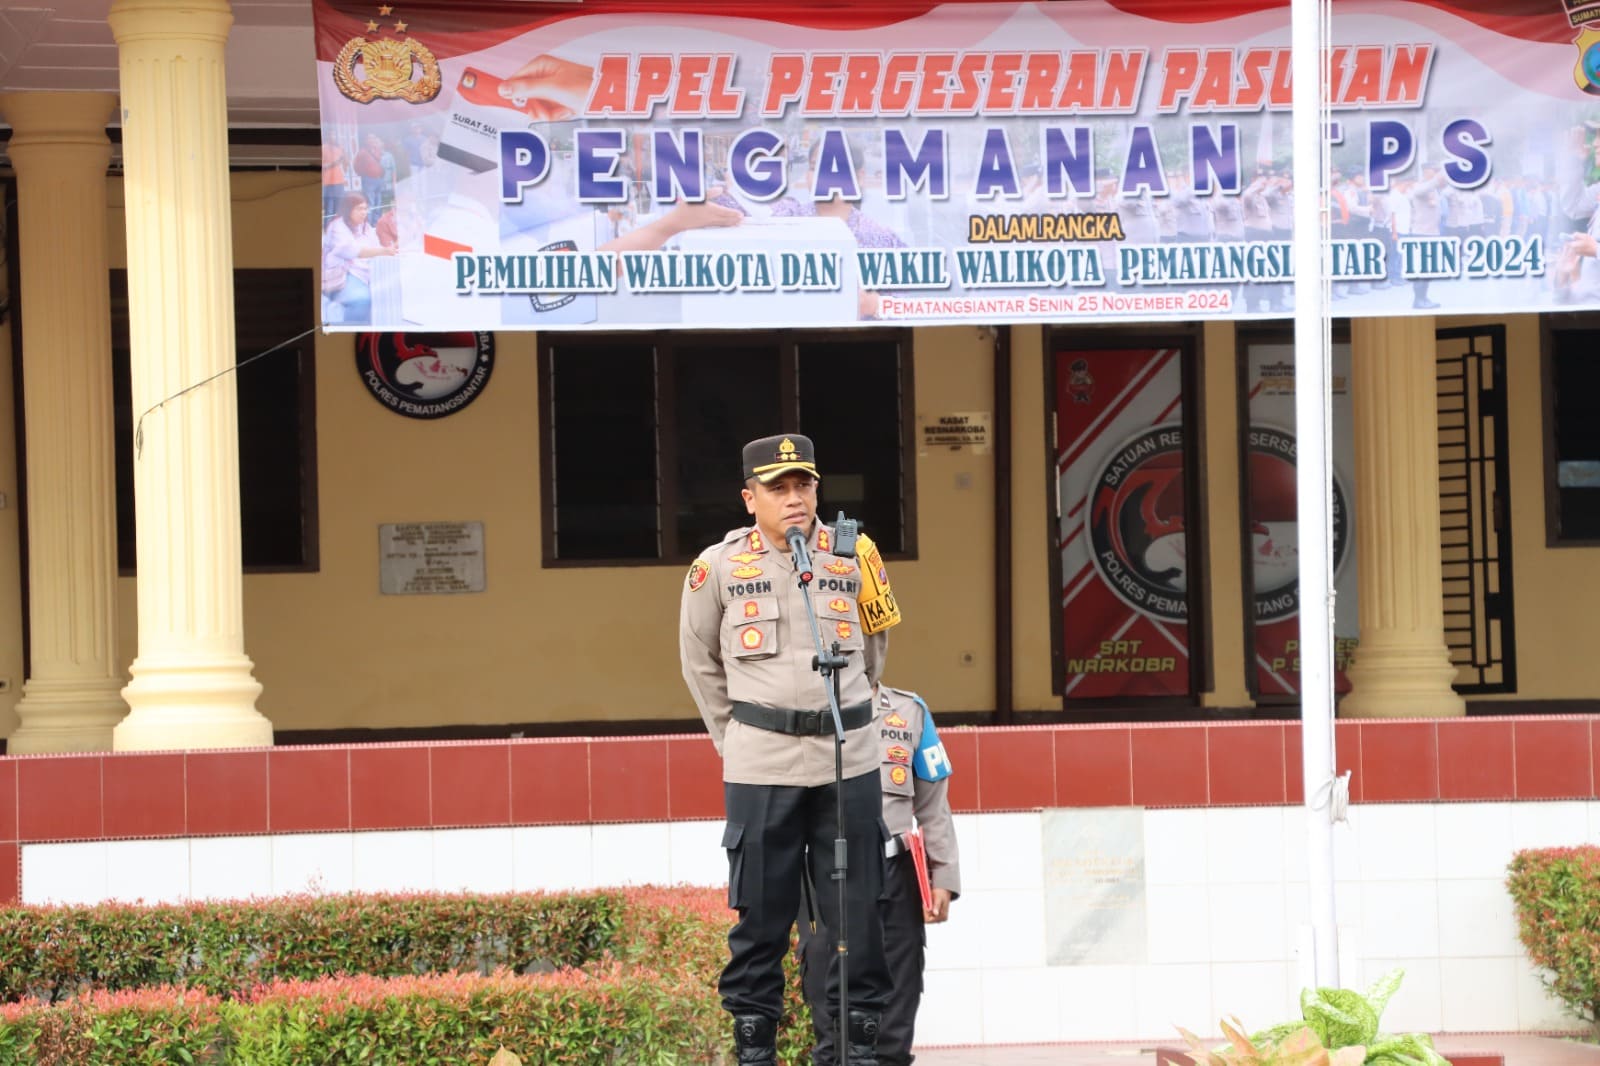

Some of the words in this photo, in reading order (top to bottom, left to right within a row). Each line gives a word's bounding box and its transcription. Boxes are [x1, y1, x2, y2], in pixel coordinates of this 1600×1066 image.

[586, 54, 742, 115] APEL
[765, 49, 1147, 114] PERGESERAN
[453, 114, 481, 128] SURAT
[500, 125, 1240, 202] PENGAMANAN
[971, 216, 1042, 241] DALAM
[1043, 215, 1123, 240] RANGKA
[456, 255, 613, 291] PEMILIHAN
[626, 254, 771, 289] WALIKOTA
[782, 252, 838, 288] DAN
[857, 251, 947, 286] WAKIL
[957, 249, 1100, 284] WALIKOTA
[1402, 240, 1458, 276] THN
[1466, 237, 1543, 275] 2024
[1078, 296, 1098, 312] 25
[1188, 294, 1229, 309] 2024
[365, 370, 398, 406] POLRES
[400, 366, 488, 415] PEMATANGSIANTAR
[1105, 437, 1157, 487] SATUAN
[818, 578, 857, 594] POLRI
[1102, 550, 1146, 601] POLRES
[727, 580, 772, 597] YOGEN
[865, 599, 886, 622] KA
[1100, 640, 1143, 655] SAT
[1067, 657, 1176, 673] NARKOBA
[881, 729, 913, 743] POLRI
